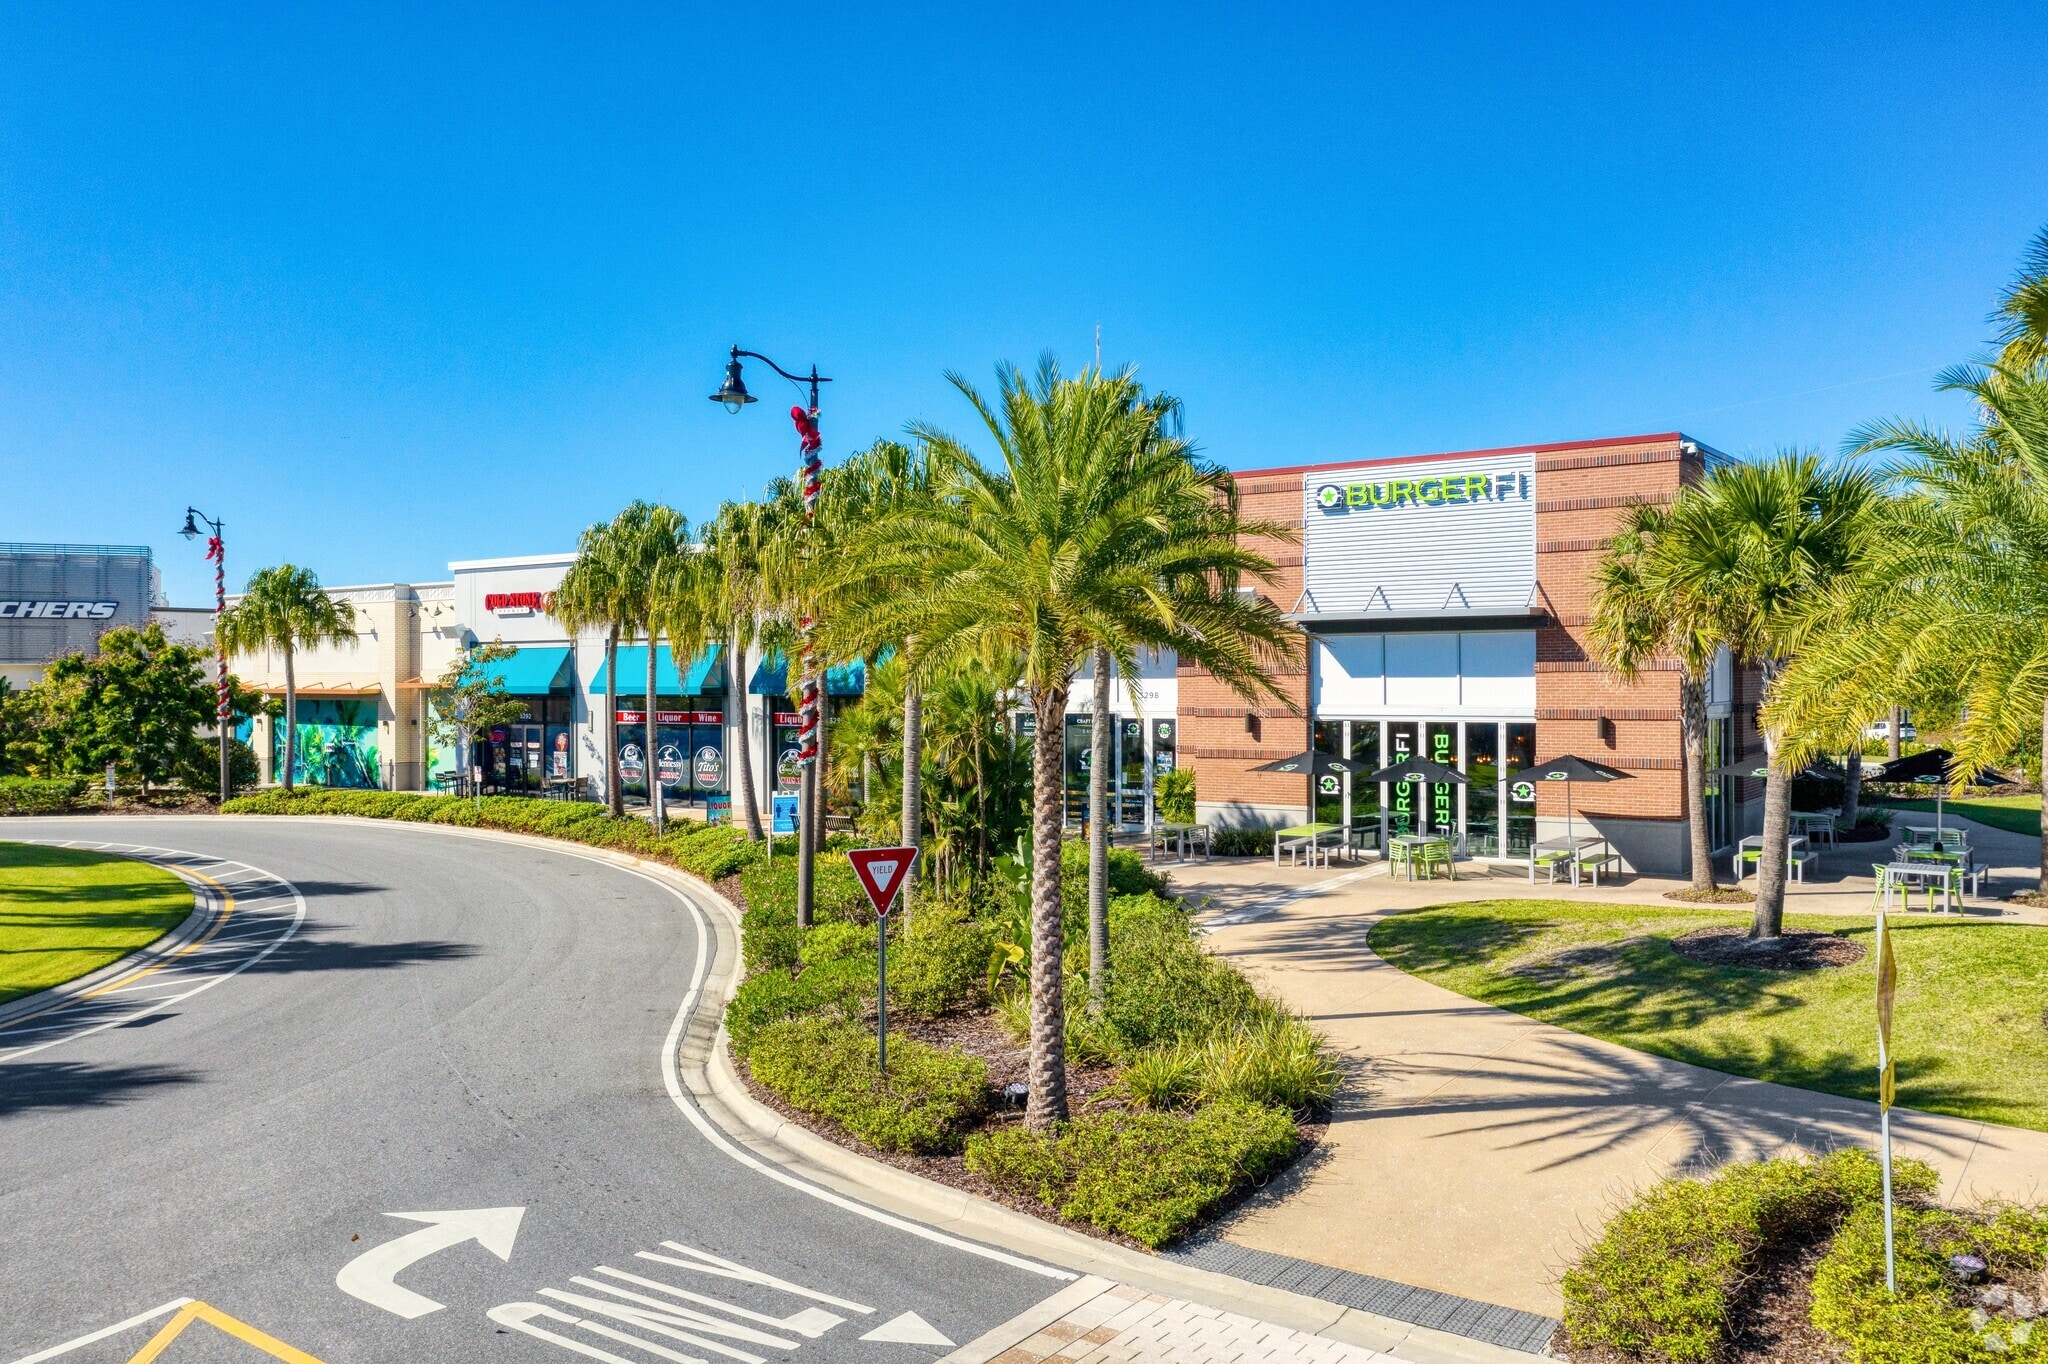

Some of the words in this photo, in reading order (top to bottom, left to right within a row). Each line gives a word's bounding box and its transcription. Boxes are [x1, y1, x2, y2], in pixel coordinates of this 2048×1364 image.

[1346, 471, 1520, 506] BURGERFI
[0, 602, 117, 618] CHERS
[623, 713, 640, 722] Beer
[657, 713, 682, 723] Liquor
[698, 714, 717, 722] Wine
[780, 714, 803, 725] Liquo
[698, 761, 719, 772] Tito's
[1395, 733, 1411, 836] BURGRFI
[708, 802, 732, 810] LIQUOR
[872, 865, 893, 875] YIELD
